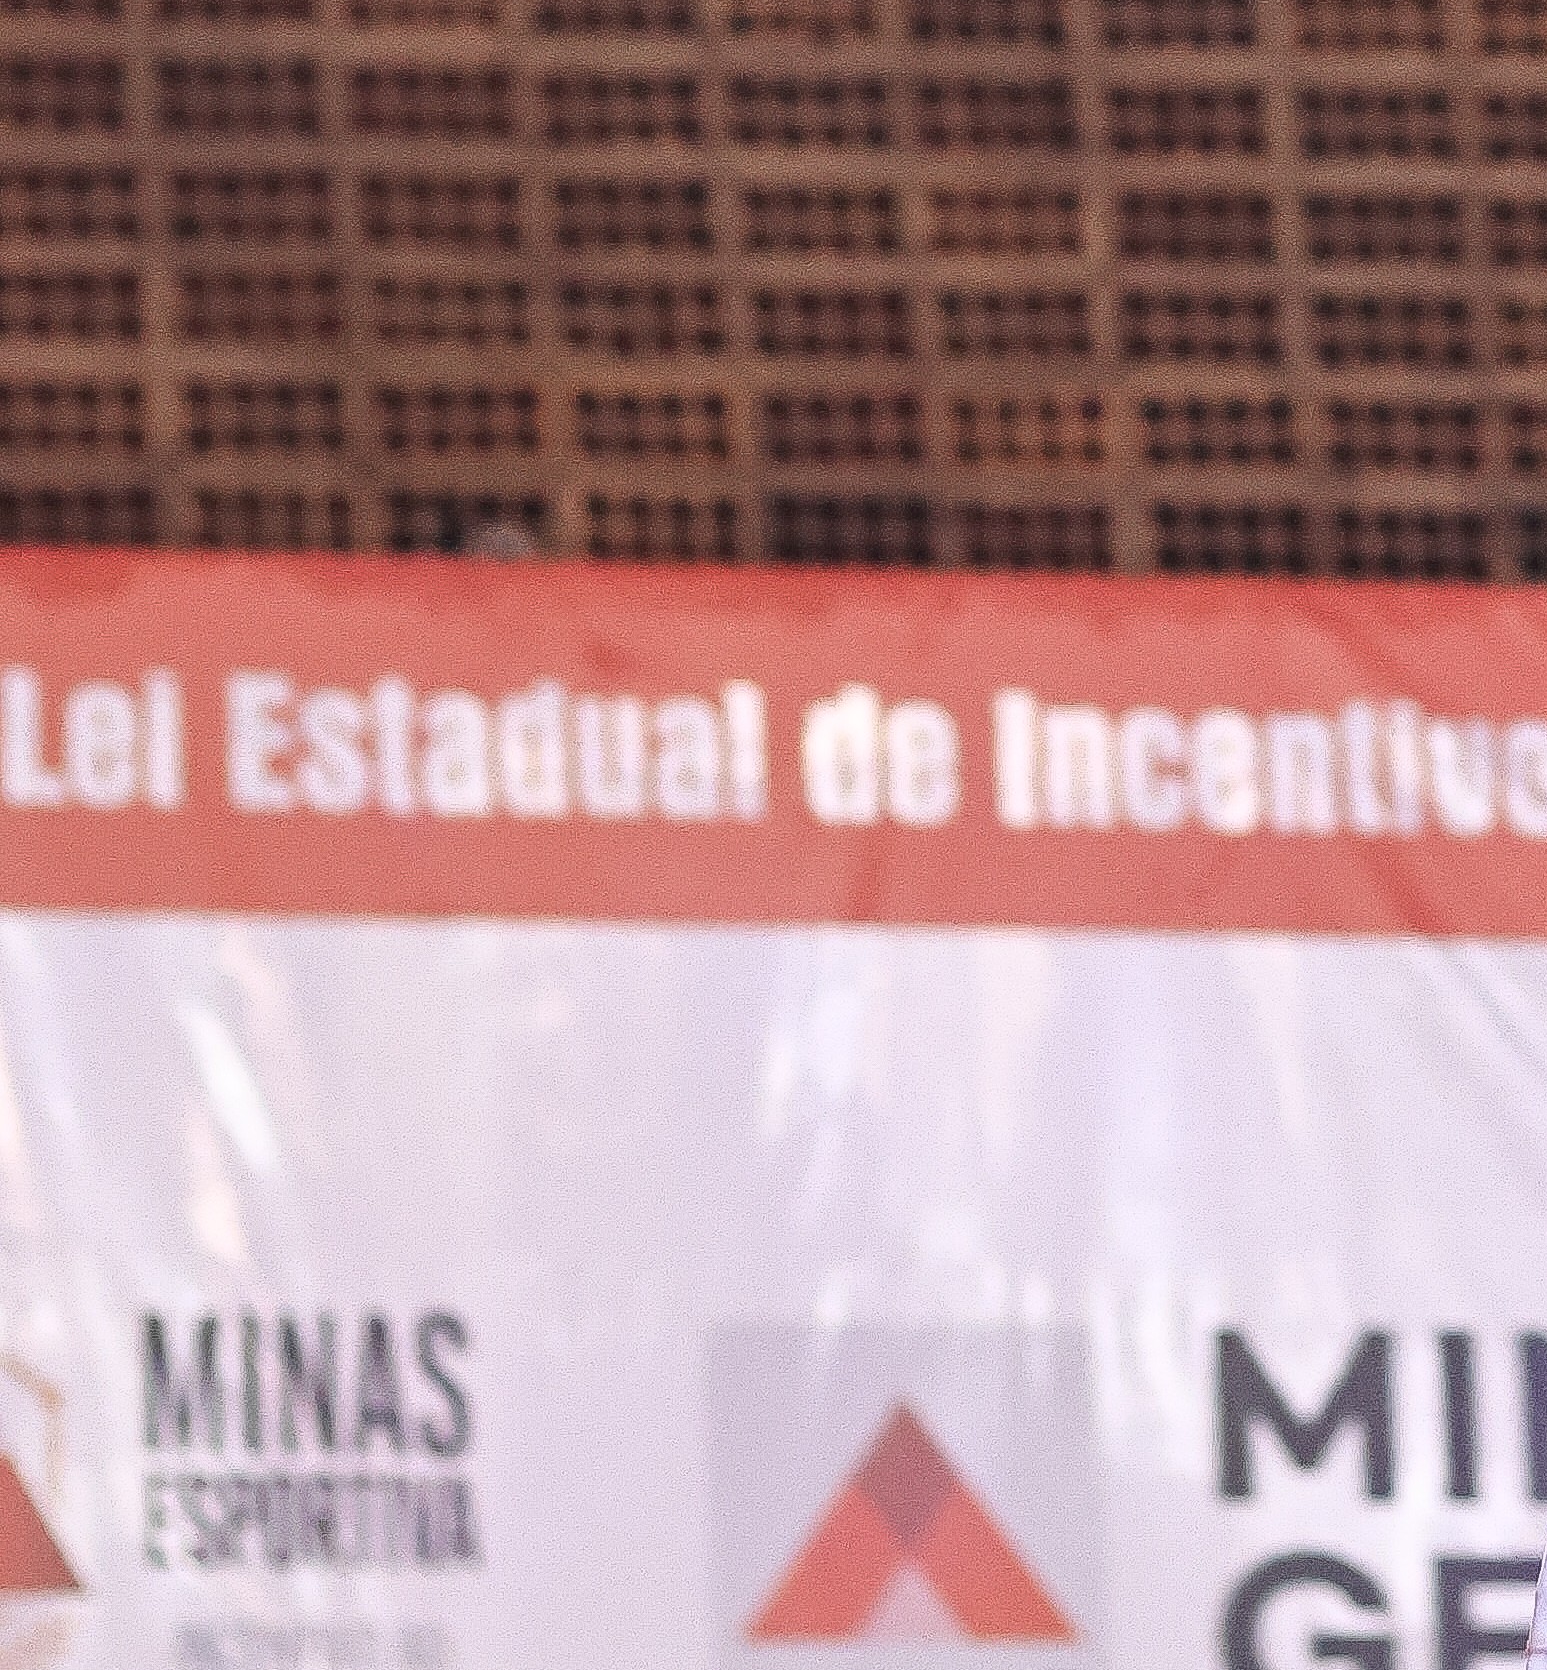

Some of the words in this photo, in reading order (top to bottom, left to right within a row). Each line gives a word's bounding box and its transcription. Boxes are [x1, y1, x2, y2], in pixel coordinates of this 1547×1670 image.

[1, 664, 186, 813] Lei
[225, 669, 769, 823] Estadual
[802, 680, 962, 831] de
[141, 1308, 473, 1457] MINAS
